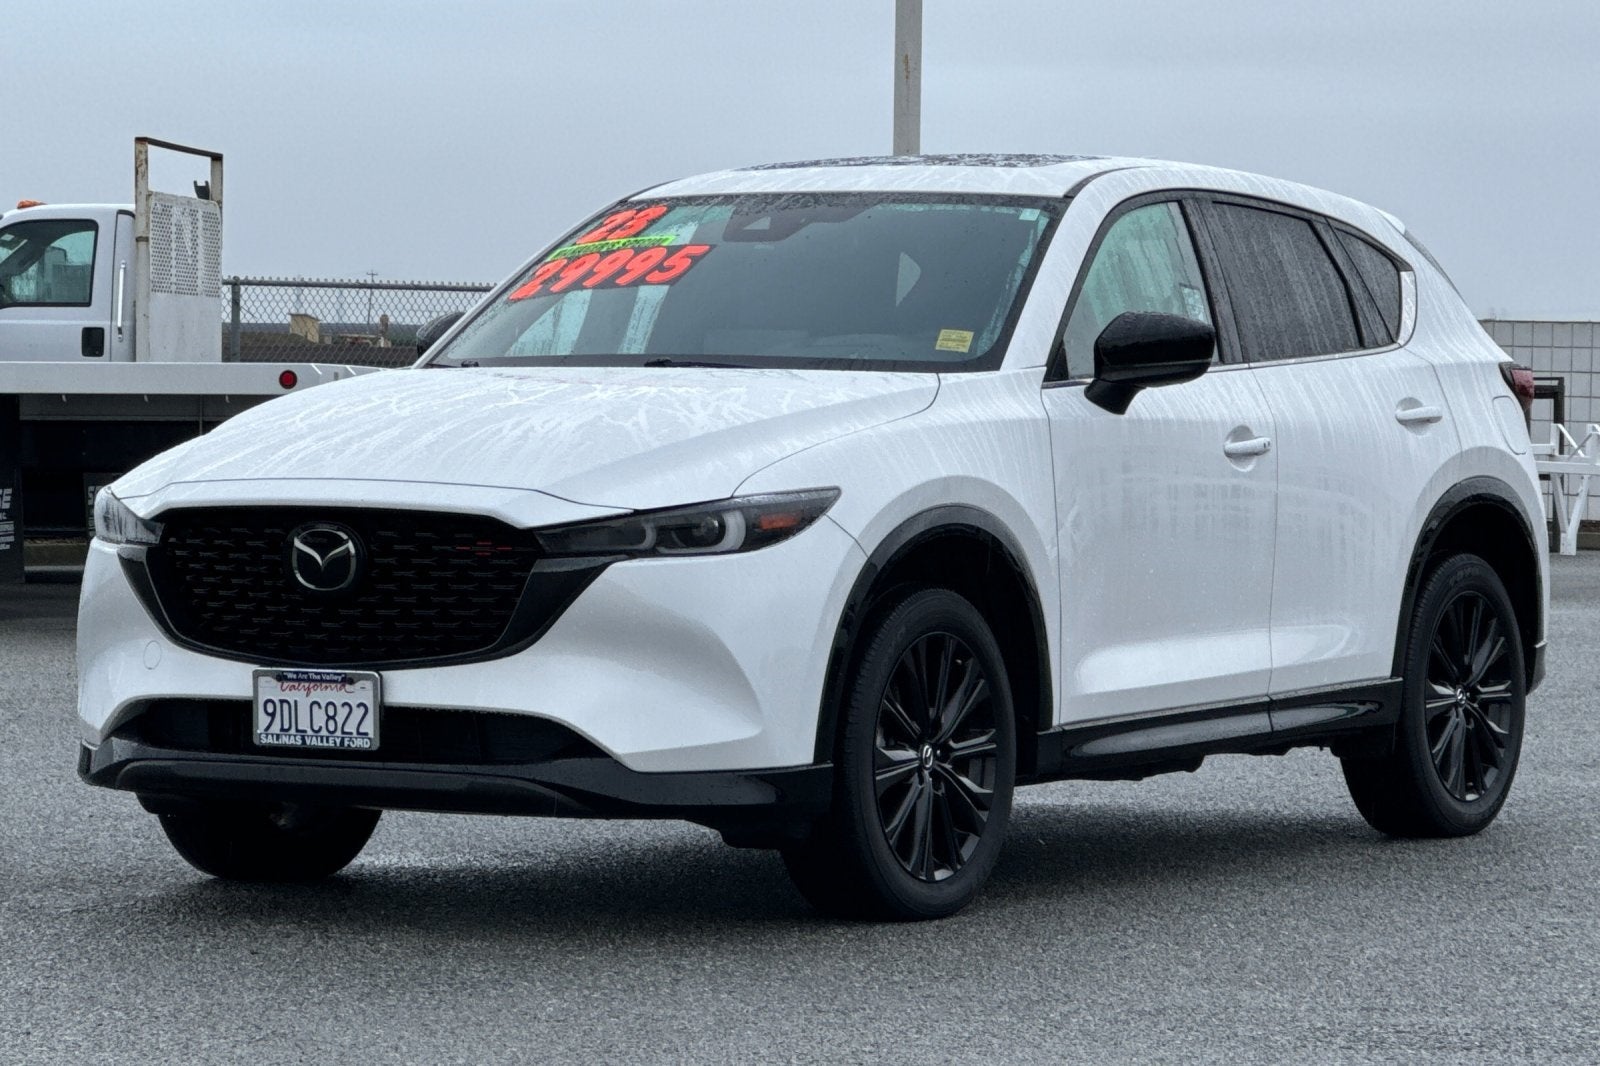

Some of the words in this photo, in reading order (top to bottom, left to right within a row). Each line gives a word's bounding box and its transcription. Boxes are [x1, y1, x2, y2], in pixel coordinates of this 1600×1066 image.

[508, 244, 711, 299] 29995
[280, 682, 355, 697] California
[263, 698, 369, 736] 9DLC822
[260, 734, 302, 745] SALINAS
[304, 736, 340, 746] VALLEY
[344, 738, 371, 748] FORD
